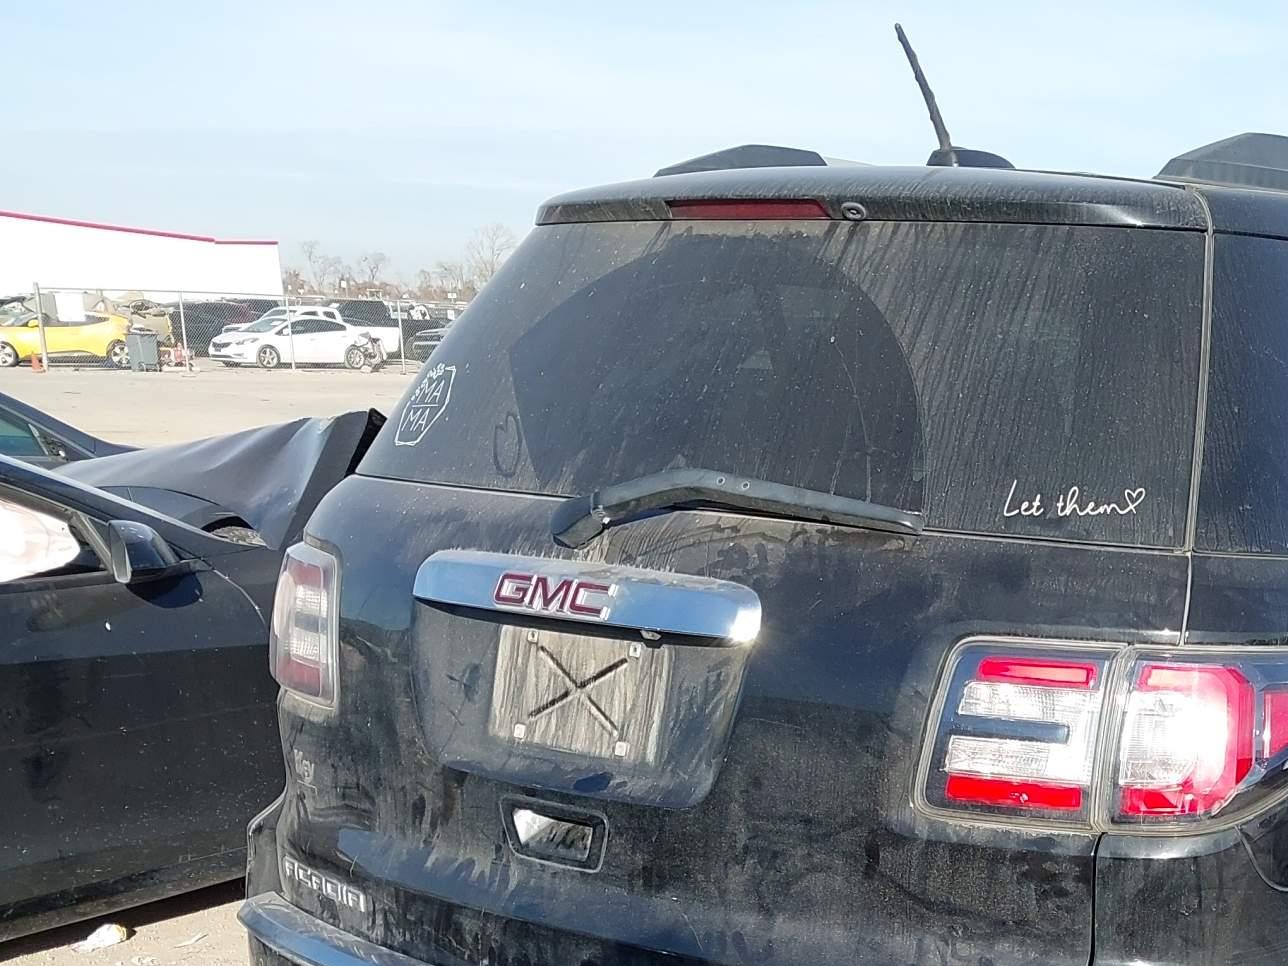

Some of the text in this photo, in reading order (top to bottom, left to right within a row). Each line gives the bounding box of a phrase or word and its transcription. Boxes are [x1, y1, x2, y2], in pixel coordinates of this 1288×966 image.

[416, 379, 445, 403] MA
[401, 407, 430, 431] MA
[1003, 479, 1127, 517] Let them
[494, 571, 619, 621] GMC
